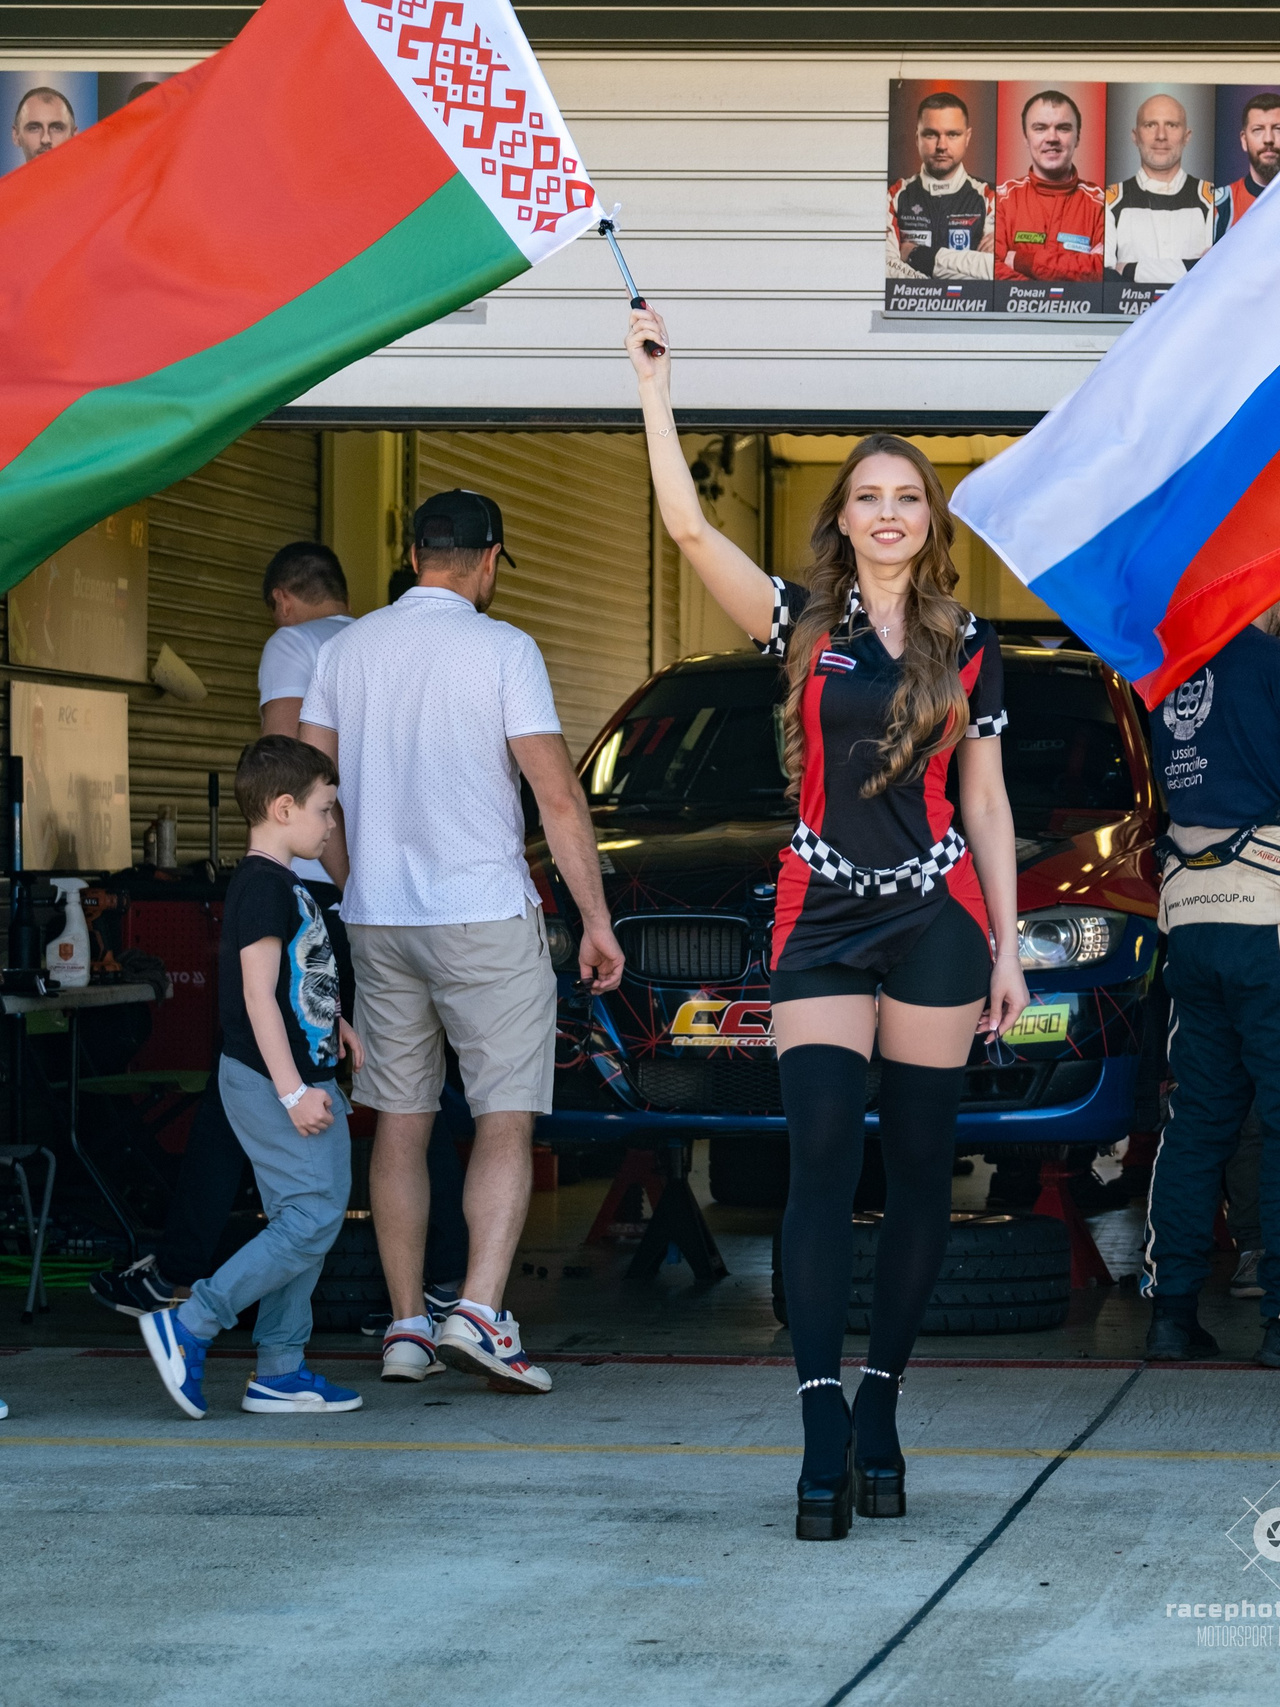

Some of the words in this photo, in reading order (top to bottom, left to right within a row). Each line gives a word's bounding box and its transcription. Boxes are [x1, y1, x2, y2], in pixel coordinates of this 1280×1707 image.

[893, 284, 942, 297] Максим
[1009, 287, 1046, 298] Роман
[1121, 288, 1151, 300] Илья
[889, 298, 987, 312] ГОРДЮШКИН
[1006, 299, 1091, 313] ОВСИЕНКО
[1170, 744, 1197, 761] ussian
[1011, 1012, 1061, 1036] HOGO
[672, 1036, 735, 1046] CLASSIC
